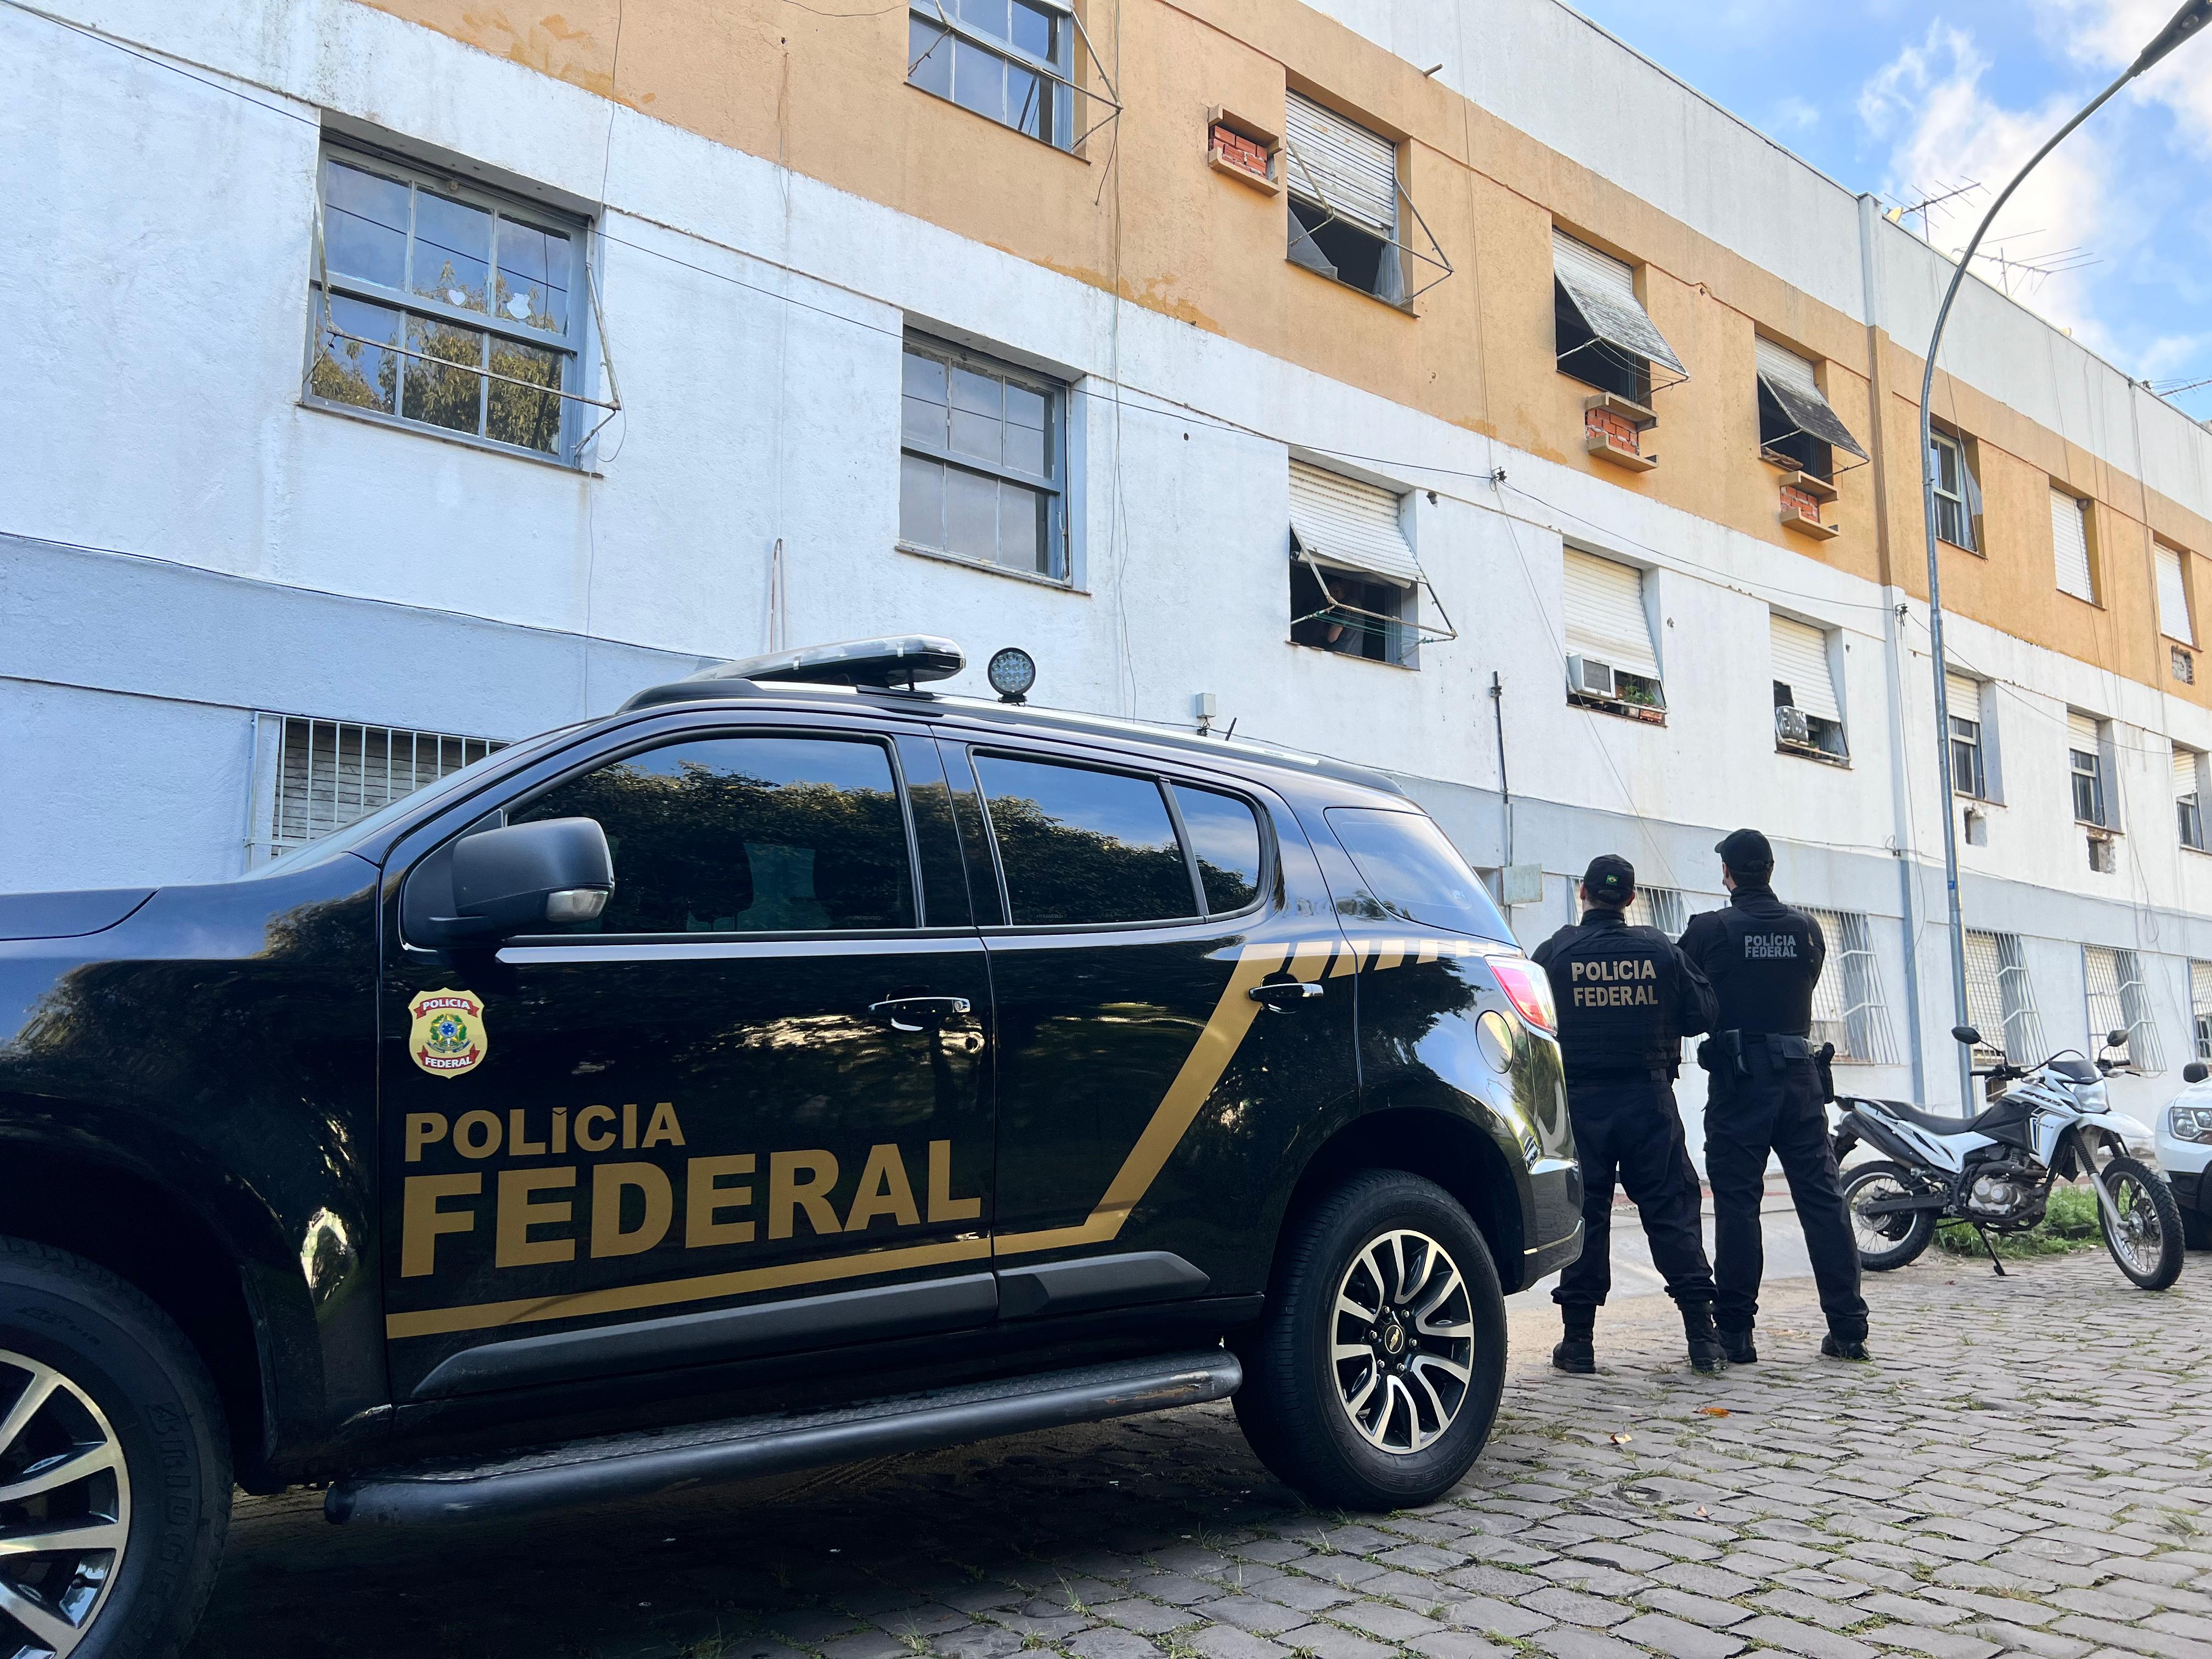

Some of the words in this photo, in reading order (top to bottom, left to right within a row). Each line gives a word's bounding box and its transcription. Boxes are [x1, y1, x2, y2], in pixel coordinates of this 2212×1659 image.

[1745, 932, 1796, 946] POLÍCIA
[1745, 946, 1797, 957] FEDERAL
[1573, 985, 1658, 1007] FEDERAL
[425, 1056, 472, 1068] FEDERAL
[400, 1139, 982, 1278] FEDERAL
